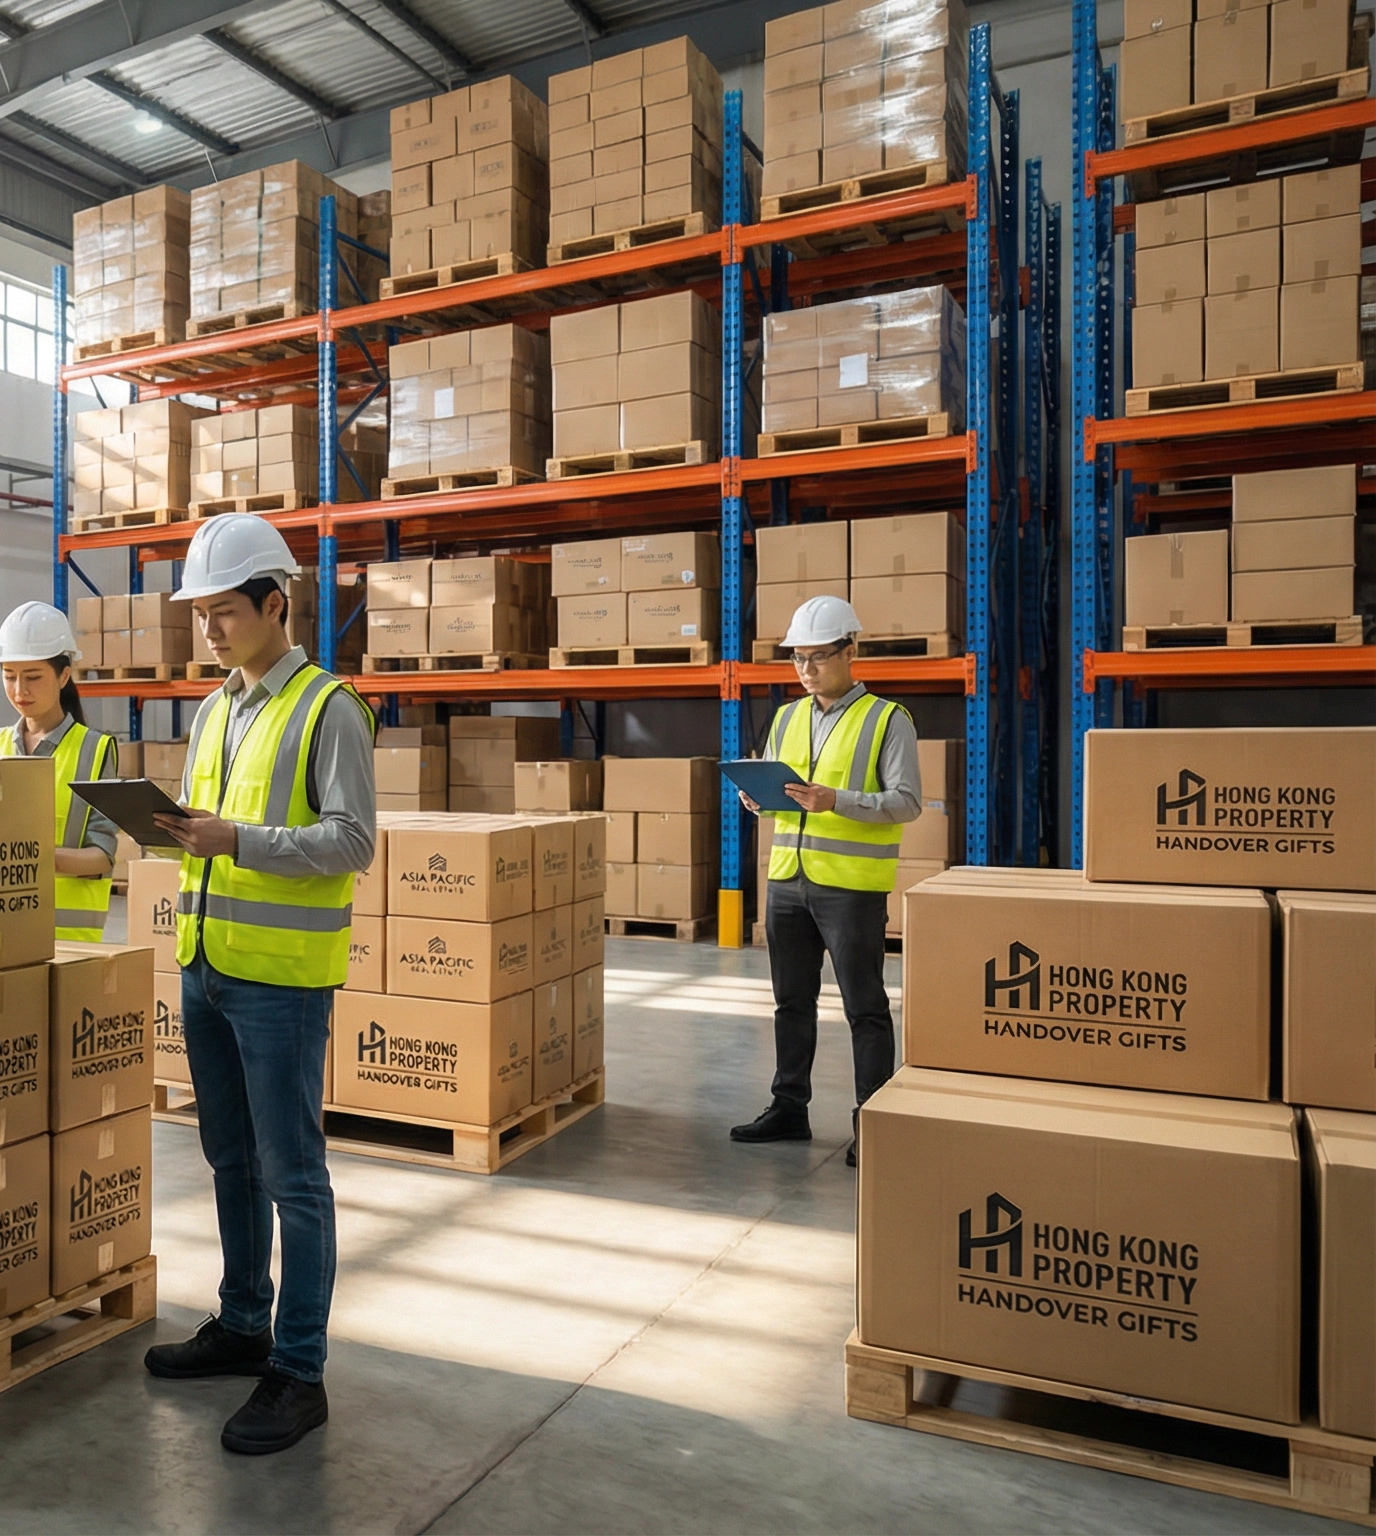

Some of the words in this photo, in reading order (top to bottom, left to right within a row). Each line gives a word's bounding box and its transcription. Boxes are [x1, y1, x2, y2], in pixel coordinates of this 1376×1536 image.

[1214, 787, 1271, 804] HONG
[1278, 787, 1335, 805] KONG
[1214, 808, 1334, 828] PROPERTY
[10, 841, 39, 860] KONG
[1157, 836, 1269, 852] HANDOVER
[1275, 839, 1335, 854] GIFTS
[400, 872, 427, 883] ASIA
[431, 873, 476, 886] PACIFIC
[400, 953, 427, 965] ASIA
[1049, 964, 1114, 991] HONG
[1122, 969, 1188, 996] KONG
[1049, 990, 1187, 1023] PROPERTY
[390, 1036, 421, 1053] HONG
[426, 1040, 457, 1057] KONG
[985, 1020, 1111, 1046] HANDOVER
[1118, 1032, 1187, 1052] GIFTS
[390, 1052, 457, 1074] PROPERTY
[1033, 1222, 1110, 1258] HONG
[1120, 1235, 1199, 1271] KONG
[1033, 1254, 1197, 1305] PROPERTY
[958, 1283, 1108, 1328] HANDOVER
[1117, 1311, 1199, 1342] GIFTS
